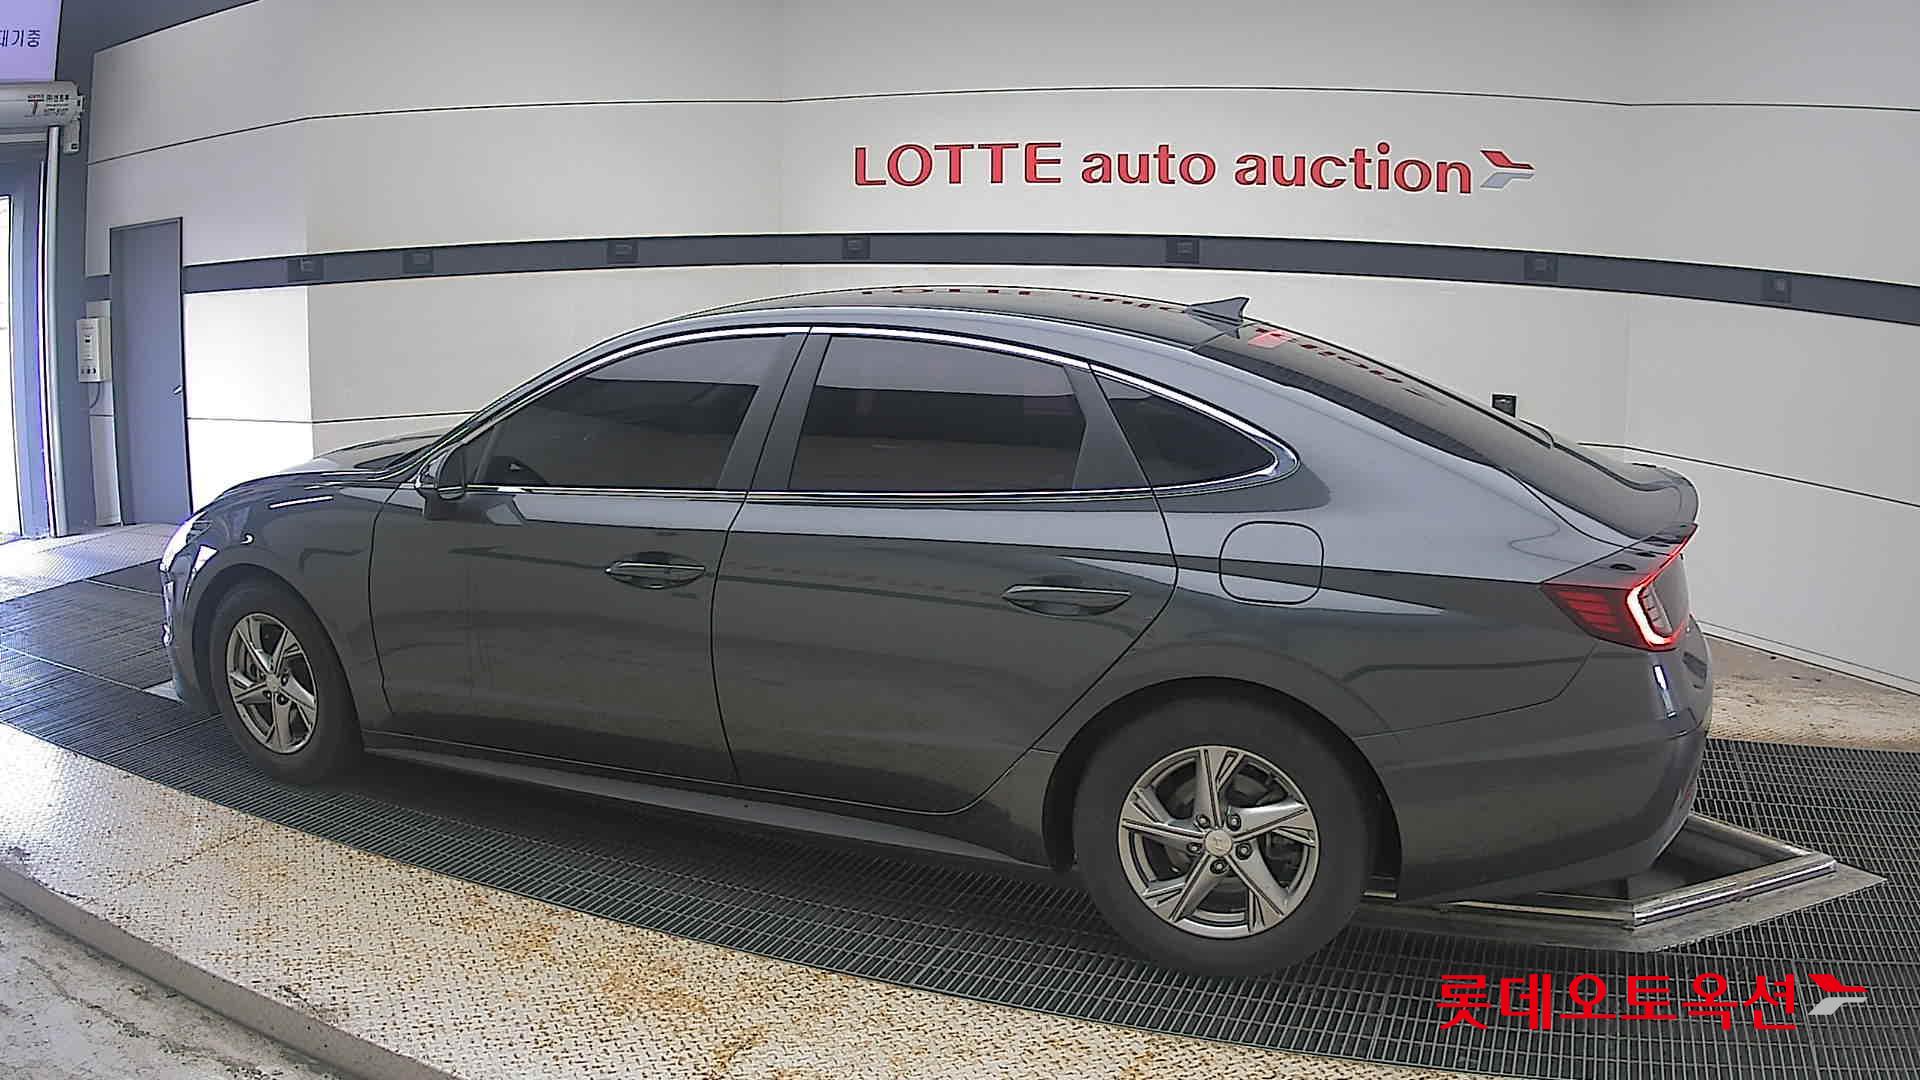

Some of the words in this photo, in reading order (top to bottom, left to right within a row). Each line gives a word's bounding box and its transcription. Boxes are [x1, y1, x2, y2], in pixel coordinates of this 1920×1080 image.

[854, 142, 1062, 187] LOTTE
[1082, 144, 1217, 185] auto
[1235, 143, 1473, 194] auction
